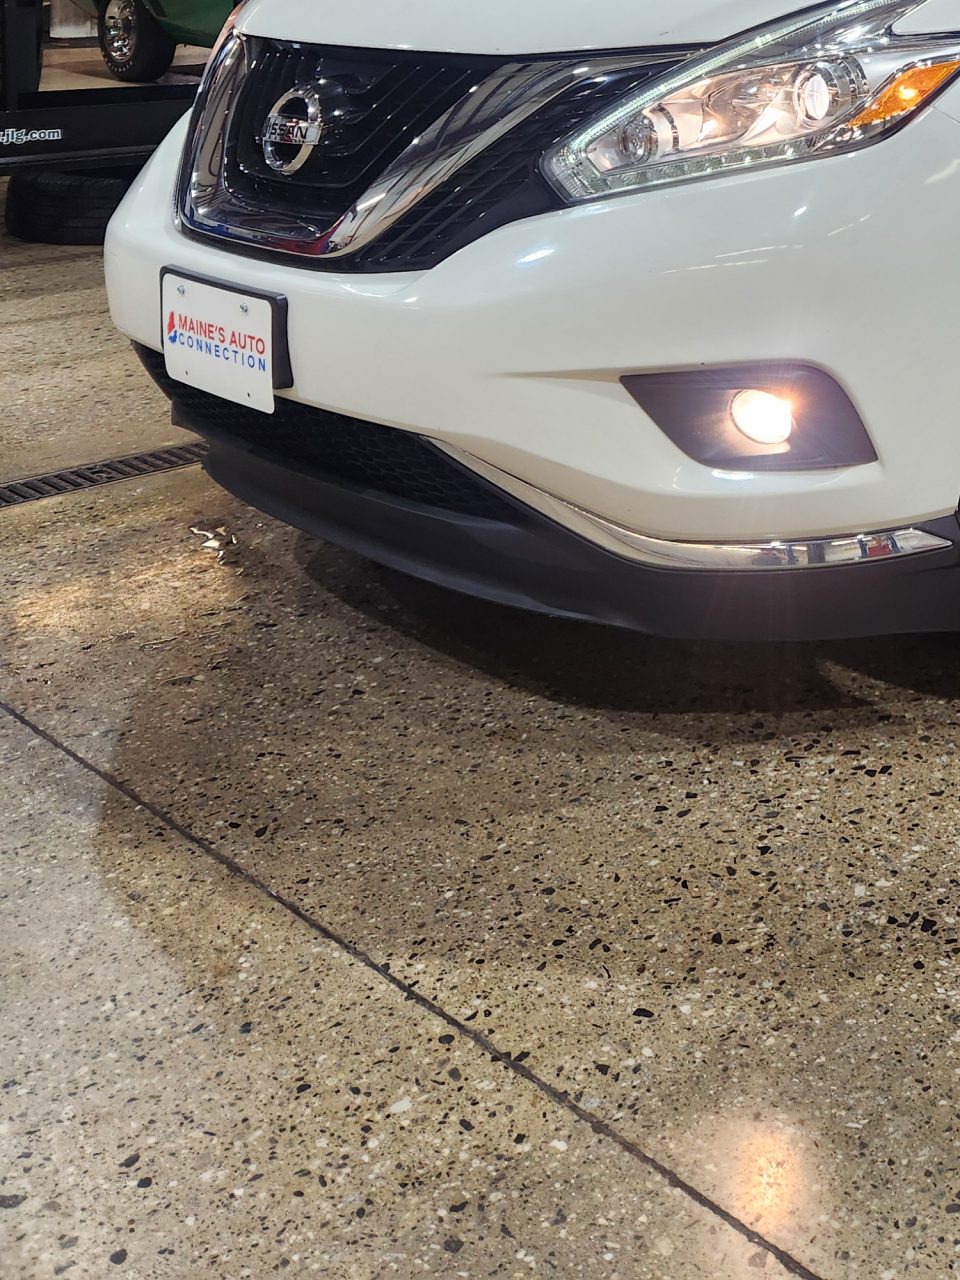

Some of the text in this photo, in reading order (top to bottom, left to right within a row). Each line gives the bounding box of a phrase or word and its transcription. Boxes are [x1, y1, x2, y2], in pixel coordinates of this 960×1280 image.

[178, 314, 266, 355] MAINE'S AUTO
[178, 333, 266, 372] CONNECTION
